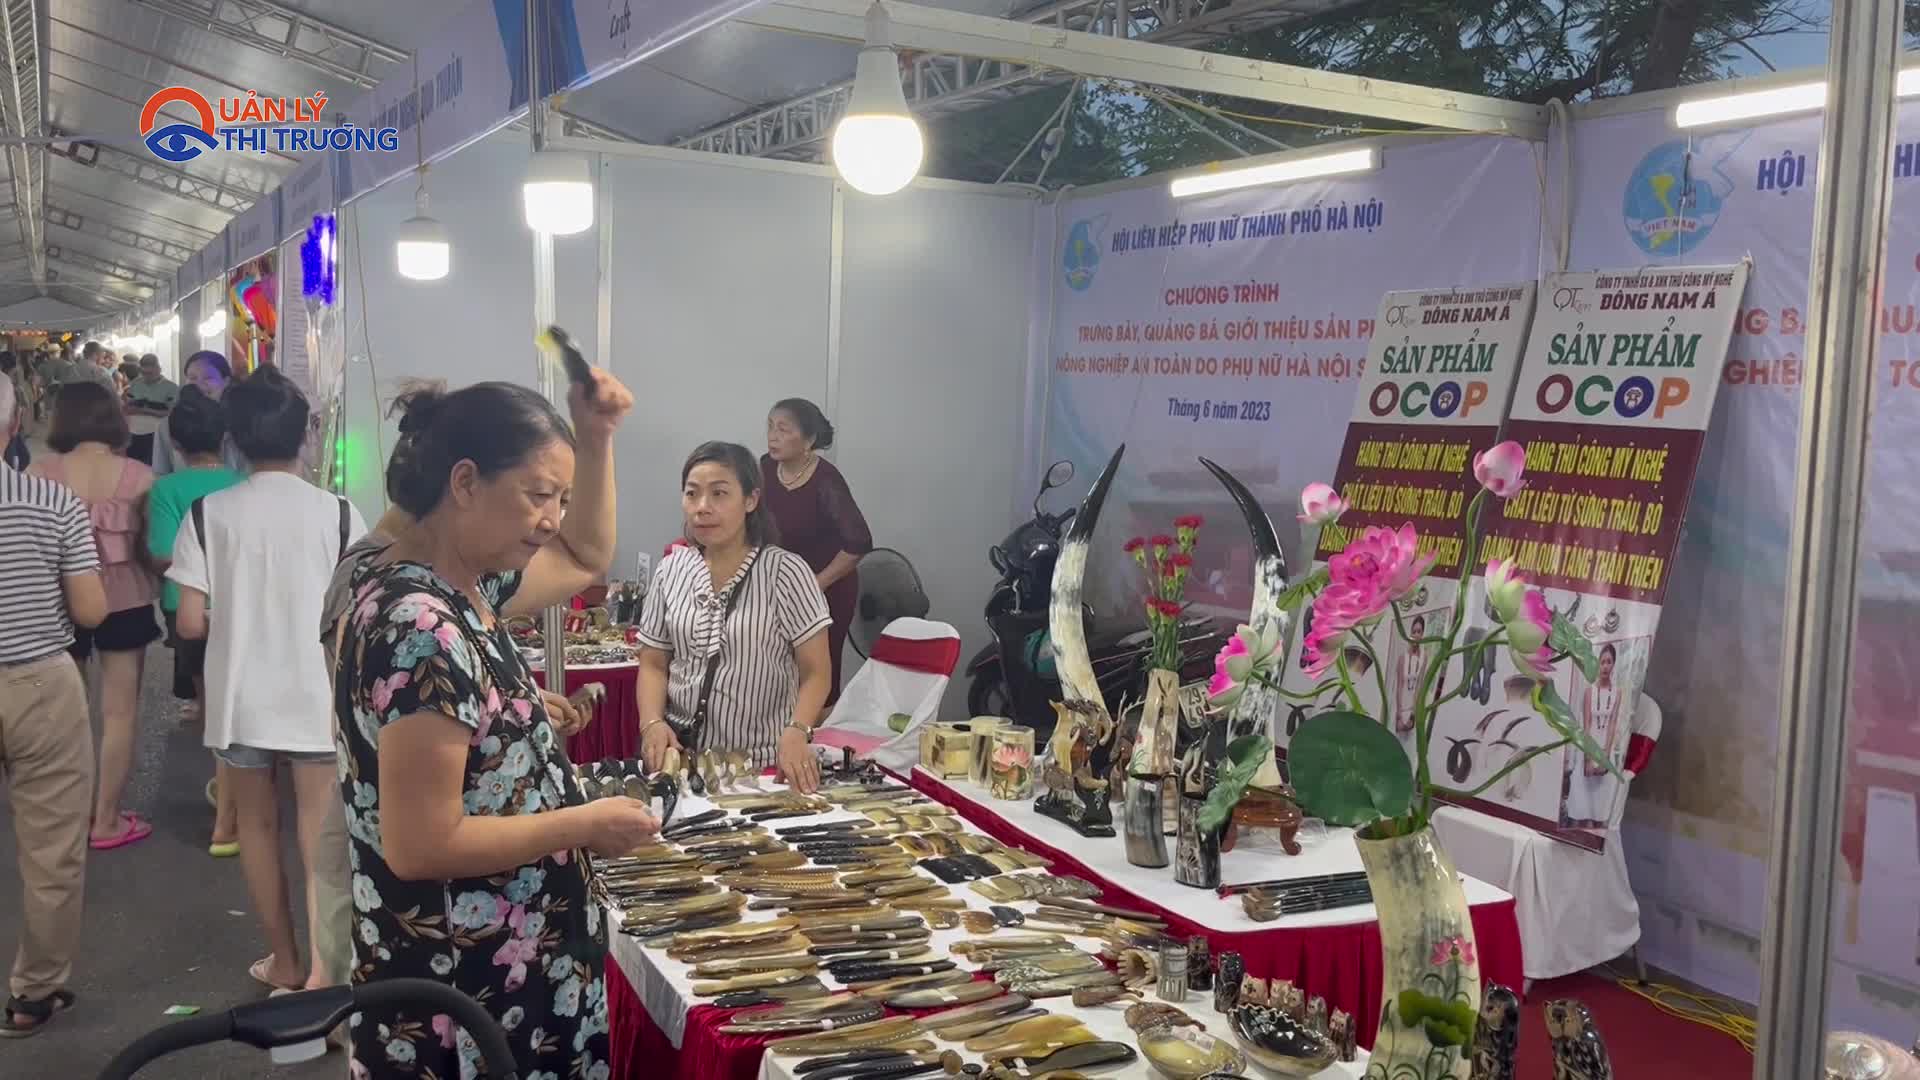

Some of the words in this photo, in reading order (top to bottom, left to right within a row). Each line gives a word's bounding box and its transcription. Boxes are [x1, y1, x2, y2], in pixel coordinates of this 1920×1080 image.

[1757, 150, 1805, 195] HỘI
[1112, 228, 1129, 255] HỘI
[1132, 225, 1156, 249] LIÊN
[1159, 219, 1187, 250] HIỆP
[1190, 220, 1216, 247] PHỤ
[1219, 214, 1240, 241] NỮ
[1291, 200, 1322, 235] PHỐ
[1327, 201, 1348, 231] HÀ
[1353, 197, 1383, 233] NỘI
[1165, 284, 1229, 306] CHƯƠNG
[1233, 279, 1279, 303] TRÌNH
[1422, 306, 1458, 325] ĐÔNG
[1461, 306, 1498, 323] NAM
[1499, 302, 1510, 321] Á
[1600, 290, 1648, 310] ĐÔNG
[1651, 291, 1699, 310] NAM
[1702, 288, 1716, 310] Á
[1144, 317, 1195, 342] QUẢNG
[1199, 318, 1218, 341] BÁ
[1224, 316, 1258, 340] GIỚI
[1264, 315, 1309, 344] THIỆU
[1313, 312, 1350, 339] SẢN
[1548, 322, 1606, 366] SẢN
[1607, 316, 1702, 368] PHẨM
[1154, 352, 1192, 375] TOÀN
[1195, 357, 1218, 376] DO
[1222, 357, 1253, 382] PHỤ
[1258, 353, 1283, 377] NỮ
[1287, 352, 1311, 377] HÀ
[1318, 352, 1350, 383] NỘI
[1380, 336, 1426, 374] SẢN
[1426, 328, 1499, 374] PHẨM
[1168, 397, 1201, 423] Tháng
[1203, 399, 1211, 418] 6
[1212, 400, 1237, 420] năm
[1240, 401, 1271, 421] 2023
[1369, 380, 1489, 418] OCOP
[1536, 373, 1691, 420] OCOP
[1355, 434, 1385, 467] HÀNG
[1380, 433, 1404, 469] THỦ
[1400, 437, 1428, 470] CÔNG
[1424, 439, 1446, 471] MỸ
[1440, 439, 1471, 479] NGHỆ
[1525, 436, 1556, 472] HÀNG
[1554, 434, 1581, 475] THỦ
[1577, 439, 1612, 477] CÔNG
[1609, 442, 1636, 479] MỸ
[1630, 443, 1669, 489] NGHỆ
[1361, 480, 1385, 517] LIỆU
[1395, 481, 1422, 515] SỪNG
[1446, 484, 1465, 519] BÒ
[1503, 480, 1534, 520] CHẤT
[1532, 486, 1557, 528] LIỆU
[1557, 488, 1577, 525] TỪ
[1573, 490, 1609, 528] SỪNG
[1642, 495, 1664, 536] BÒ
[1561, 539, 1594, 584] TẶNG
[1592, 545, 1627, 585] THÂN
[1624, 550, 1665, 596] THIỆN
